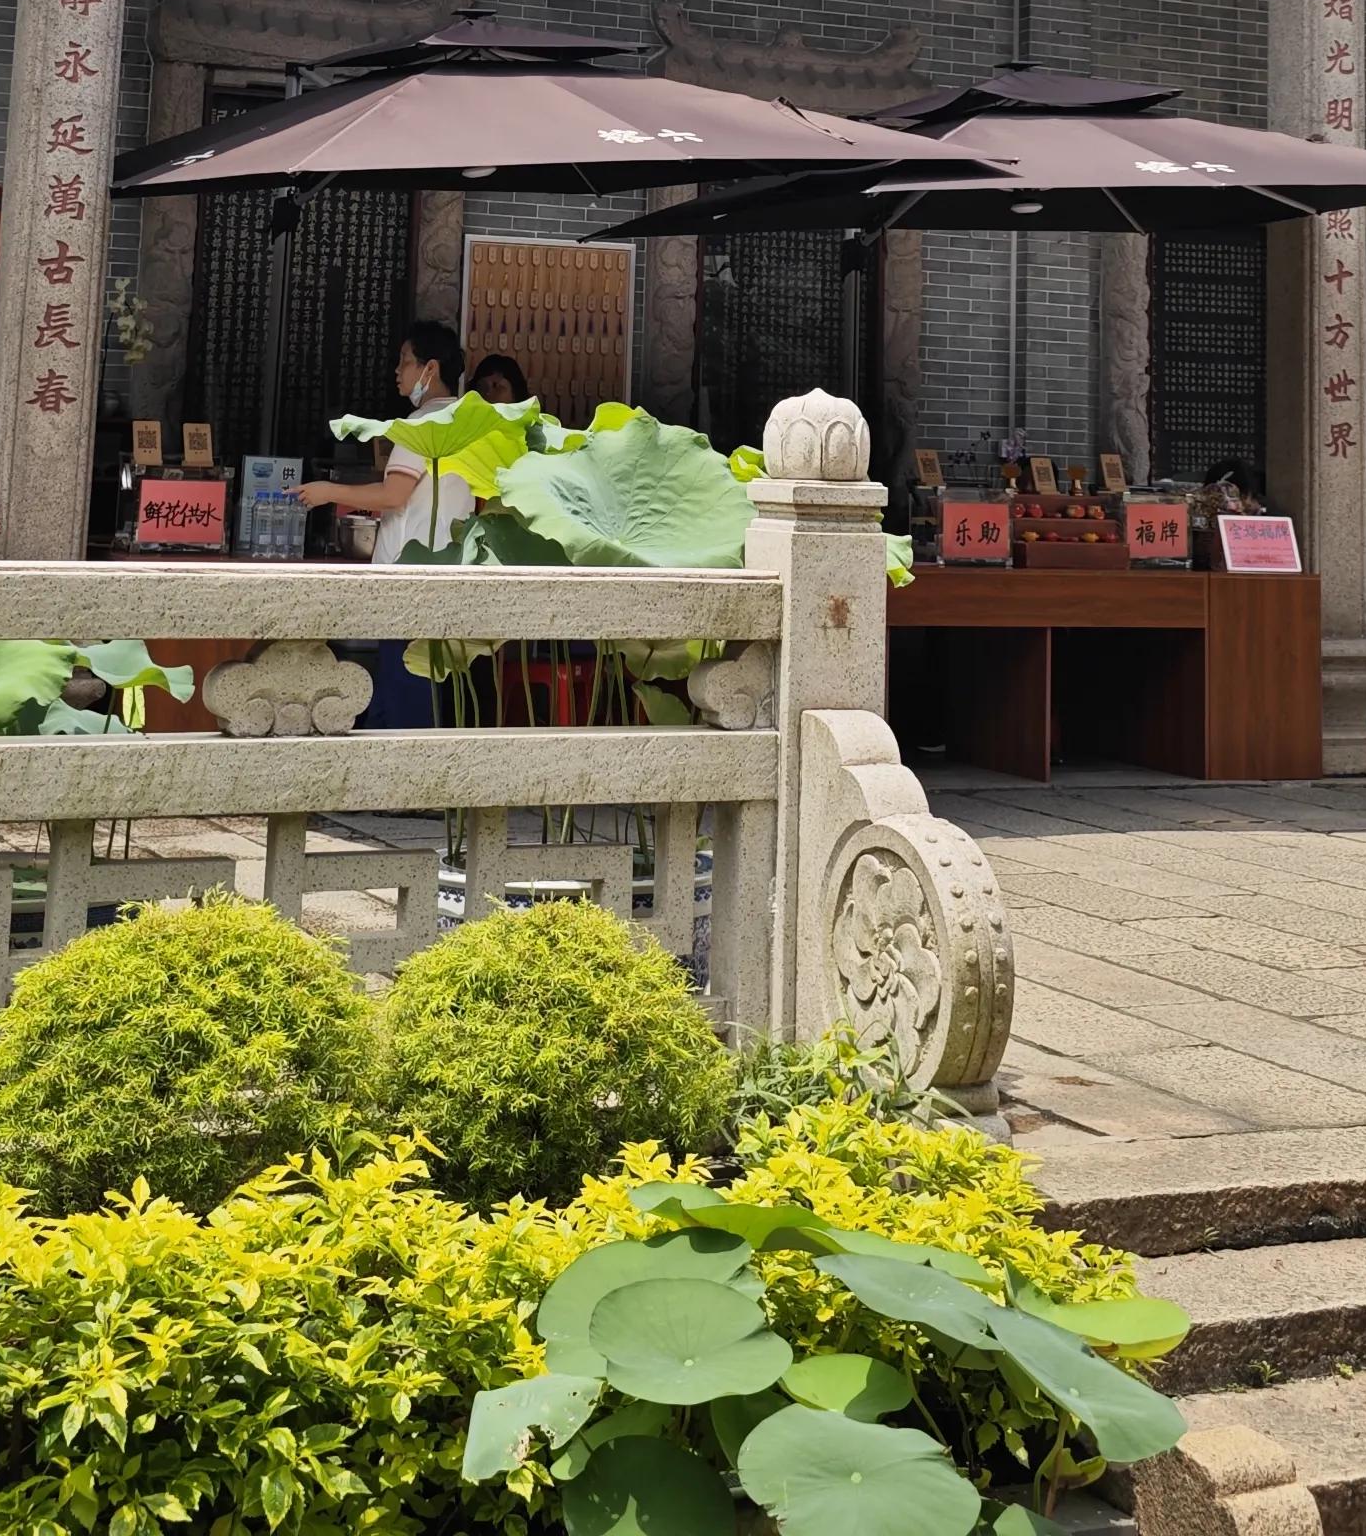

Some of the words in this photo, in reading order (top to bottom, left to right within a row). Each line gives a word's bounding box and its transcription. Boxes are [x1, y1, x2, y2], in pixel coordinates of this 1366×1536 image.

[142, 500, 223, 528] 鲜花供水
[954, 518, 1001, 547] 乐助
[1134, 519, 1180, 546] 福牌
